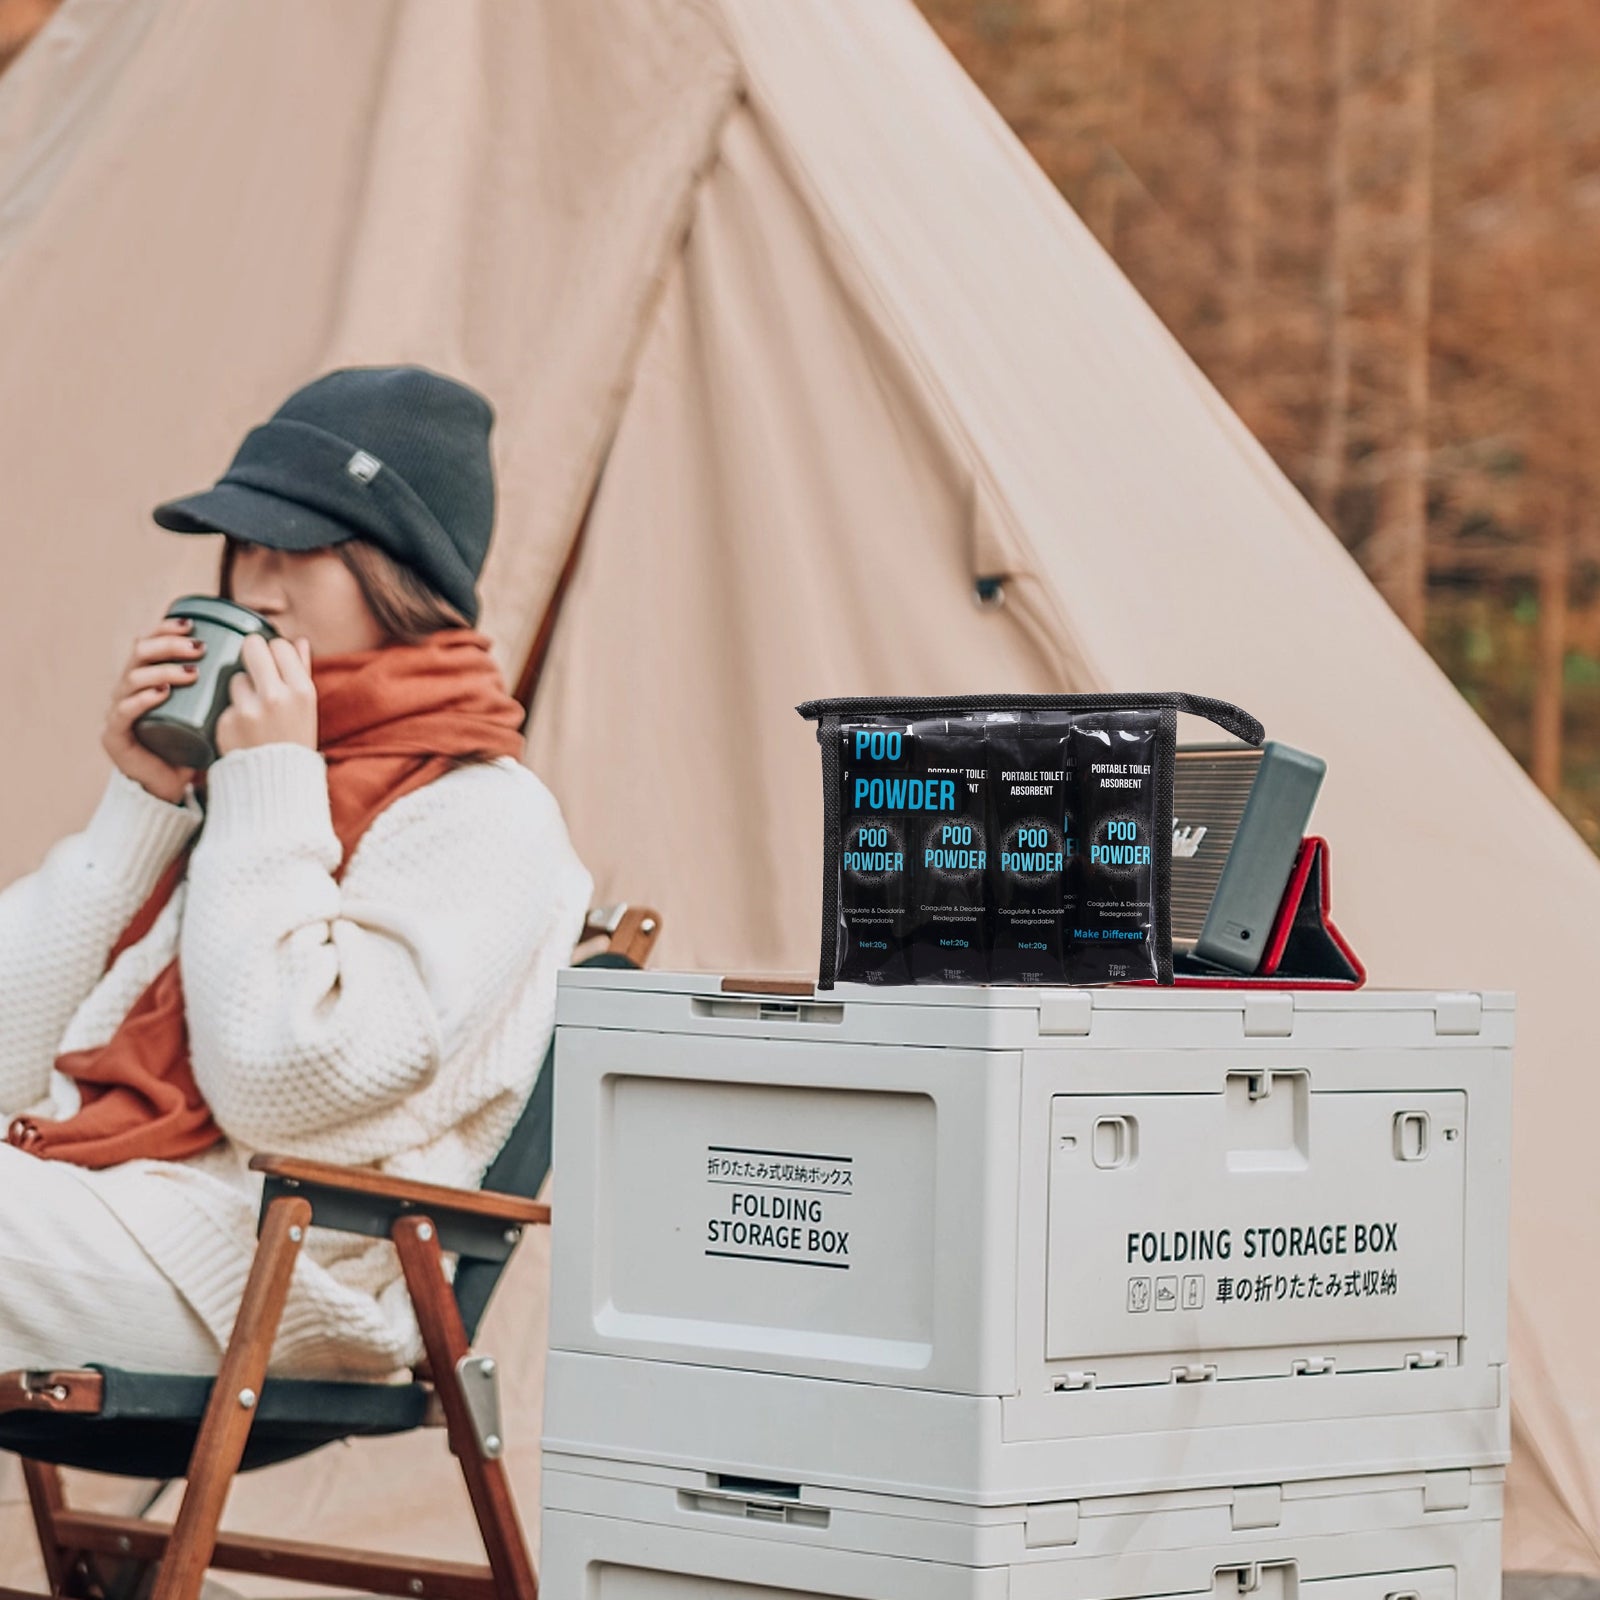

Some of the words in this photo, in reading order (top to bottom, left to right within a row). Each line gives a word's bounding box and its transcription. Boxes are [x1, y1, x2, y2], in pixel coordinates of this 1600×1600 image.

[855, 730, 902, 761] POO
[1001, 771, 1038, 781] PORTABLE
[1039, 771, 1064, 781] TOILET
[1091, 763, 1127, 775] PORTABLE
[1129, 764, 1151, 775] TOILET
[1010, 785, 1053, 796] ABSORBENT
[1100, 778, 1142, 789] ABSORBENT
[854, 778, 955, 811] POWDER
[858, 828, 888, 848] POO
[942, 825, 972, 846] POO
[1018, 828, 1048, 848] POO
[1107, 821, 1137, 841] POO
[843, 851, 904, 872] POWDER
[924, 848, 987, 870] POWDER
[1001, 852, 1063, 872] POWDER
[1090, 845, 1151, 865] POWDER
[920, 904, 953, 912] Coagulate
[998, 908, 1031, 916] Coagulate
[1086, 900, 1119, 908] Coagulate
[1010, 918, 1055, 926] Biodegradable
[939, 939, 969, 949] Net:20g
[1074, 929, 1099, 939] Make
[1102, 929, 1144, 940] Different
[859, 941, 888, 950] Net:20g
[1018, 942, 1048, 951] Net:20g
[707, 1158, 853, 1186] 折りたたみ式収納ボックス
[731, 1193, 822, 1223] FOLDING
[707, 1219, 802, 1250] STORAGE
[807, 1228, 849, 1255] BOX
[1126, 1229, 1232, 1264] FOLDING
[1242, 1225, 1348, 1259] STORAGE
[1354, 1222, 1399, 1253] BOX
[1215, 1268, 1399, 1304] 車の折りたたみ式収納
